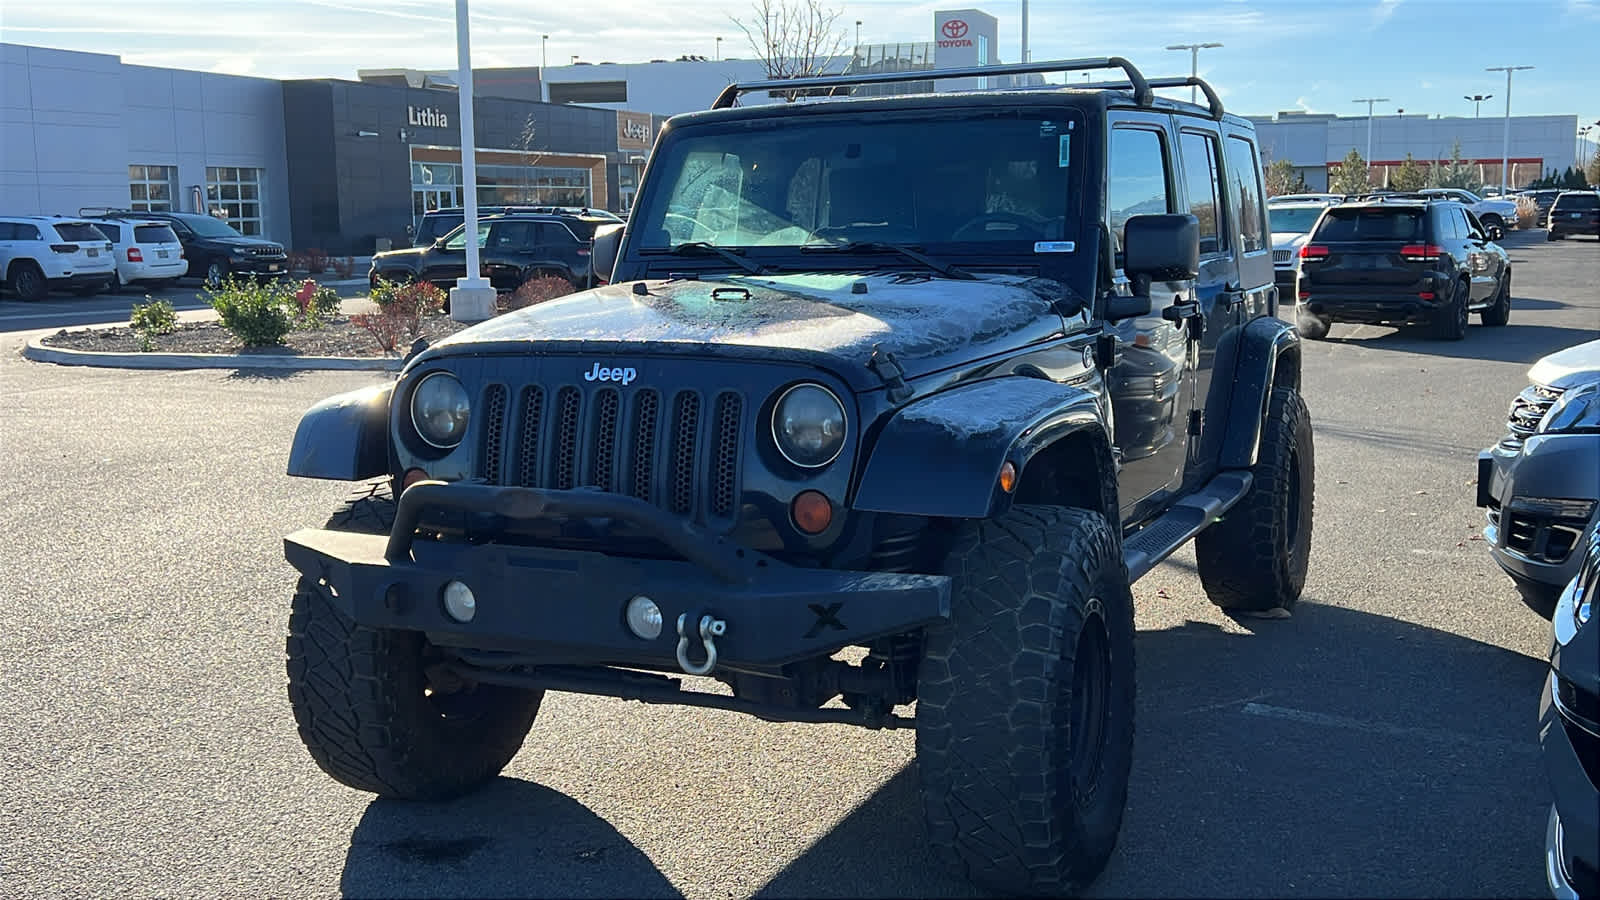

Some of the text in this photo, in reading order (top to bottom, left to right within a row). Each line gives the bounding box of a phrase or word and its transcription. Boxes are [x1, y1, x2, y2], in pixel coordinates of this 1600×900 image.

[937, 40, 973, 48] TOYOTA
[408, 106, 448, 128] Lithia
[624, 119, 650, 143] Jeep
[584, 362, 637, 386] Jeep
